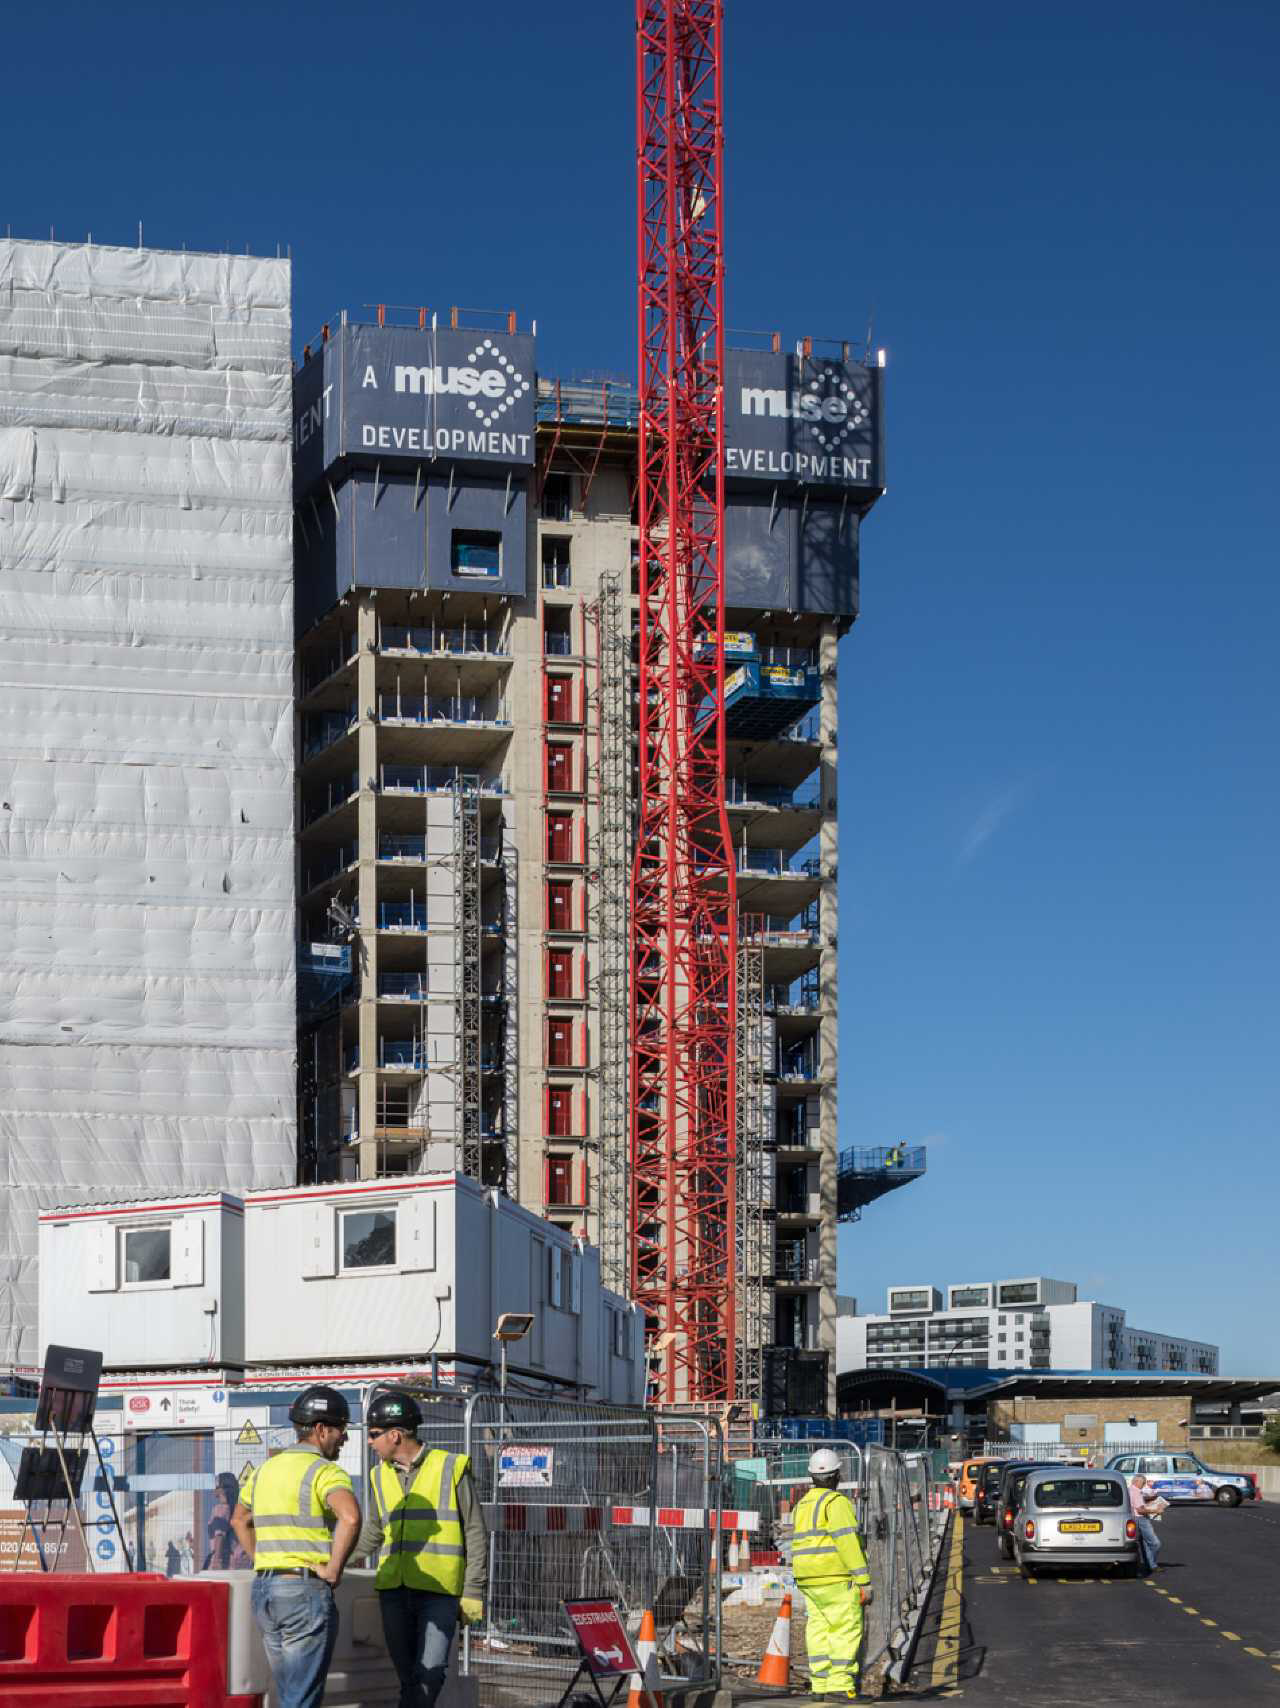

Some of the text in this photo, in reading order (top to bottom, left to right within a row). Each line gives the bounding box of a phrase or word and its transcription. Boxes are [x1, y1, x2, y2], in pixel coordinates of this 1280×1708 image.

[361, 365, 507, 398] A muse
[741, 386, 848, 424] muse
[361, 424, 531, 456] DEVELOPMENT
[725, 448, 872, 480] EVELOPMENT
[0, 1542, 18, 1553] 020
